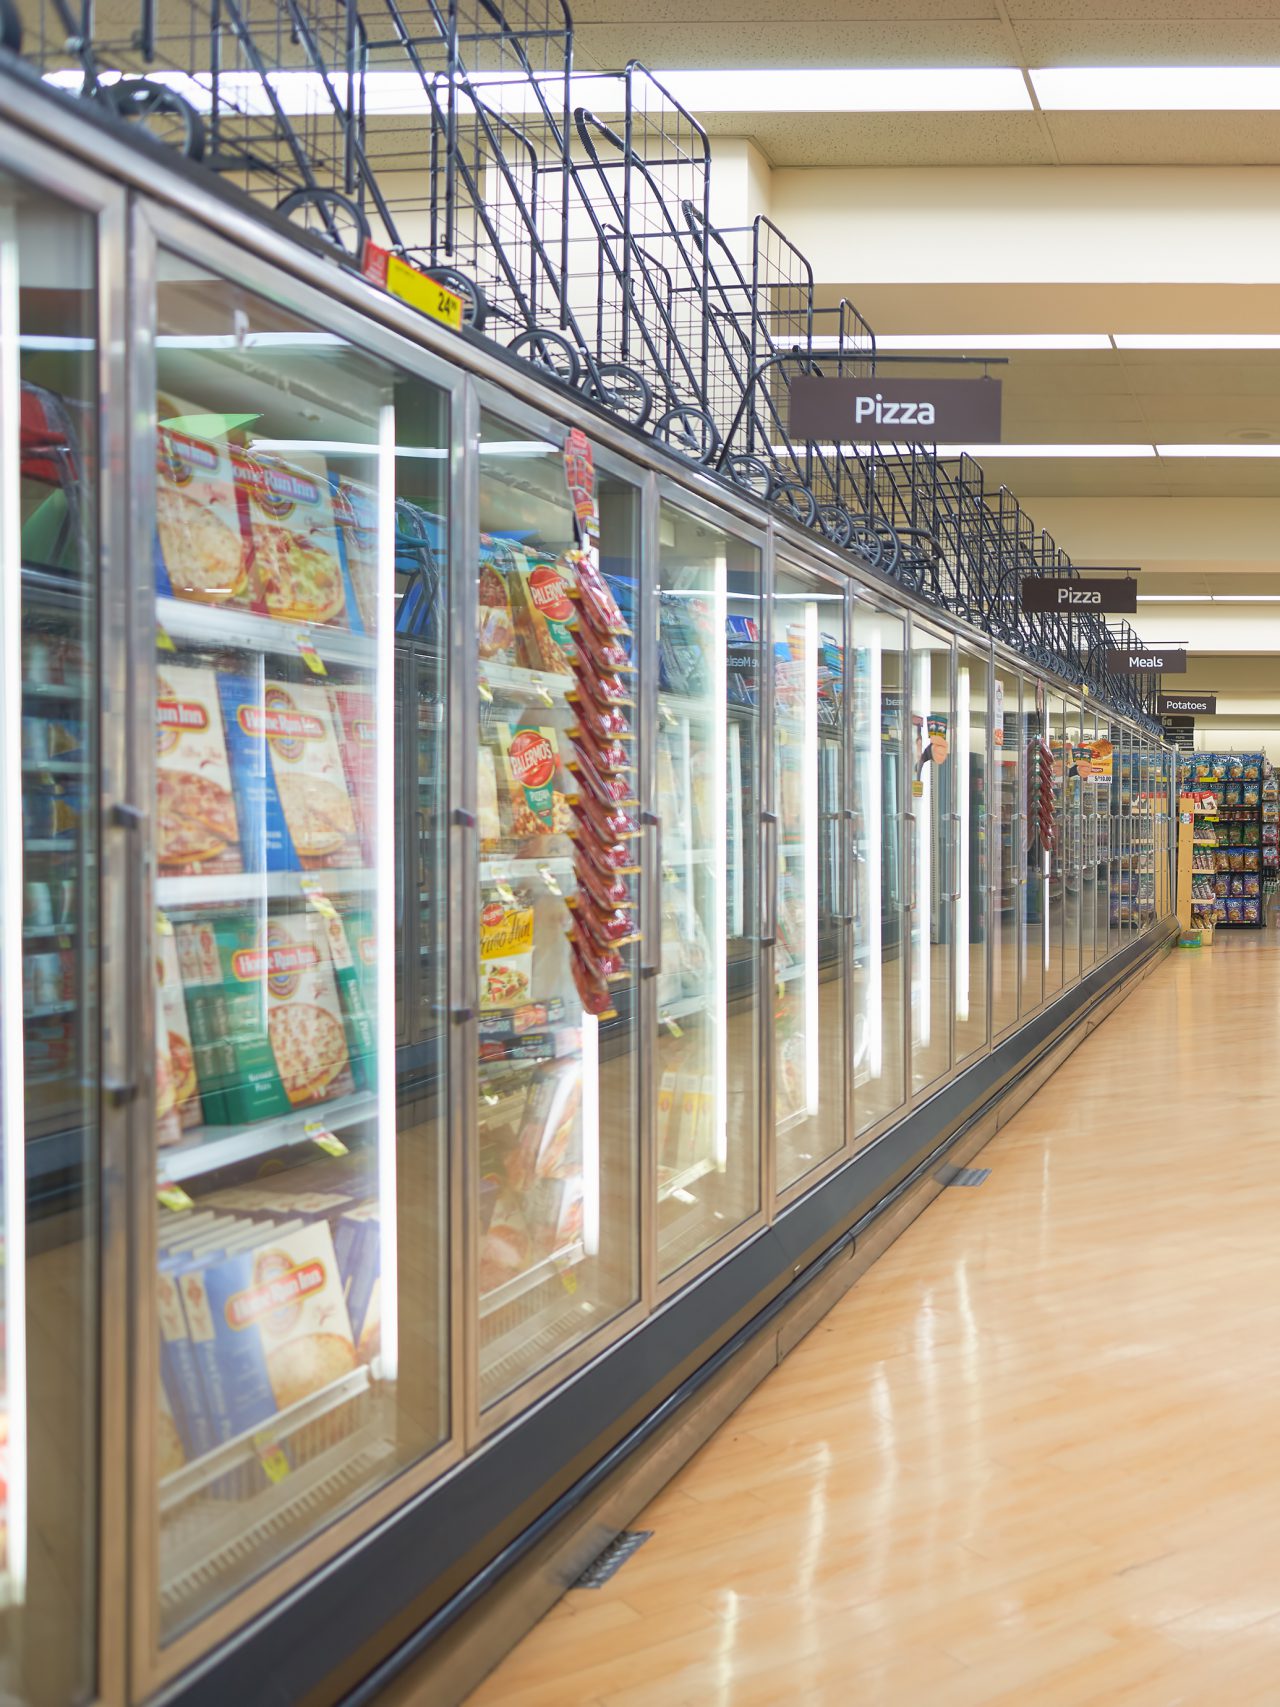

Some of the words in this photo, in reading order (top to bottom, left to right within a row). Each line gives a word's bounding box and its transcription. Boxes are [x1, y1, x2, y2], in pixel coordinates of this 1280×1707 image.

[855, 393, 935, 424] Pizza
[1057, 586, 1102, 604] Pizza
[1129, 656, 1164, 668] Meals
[1166, 700, 1208, 711] Potatoes
